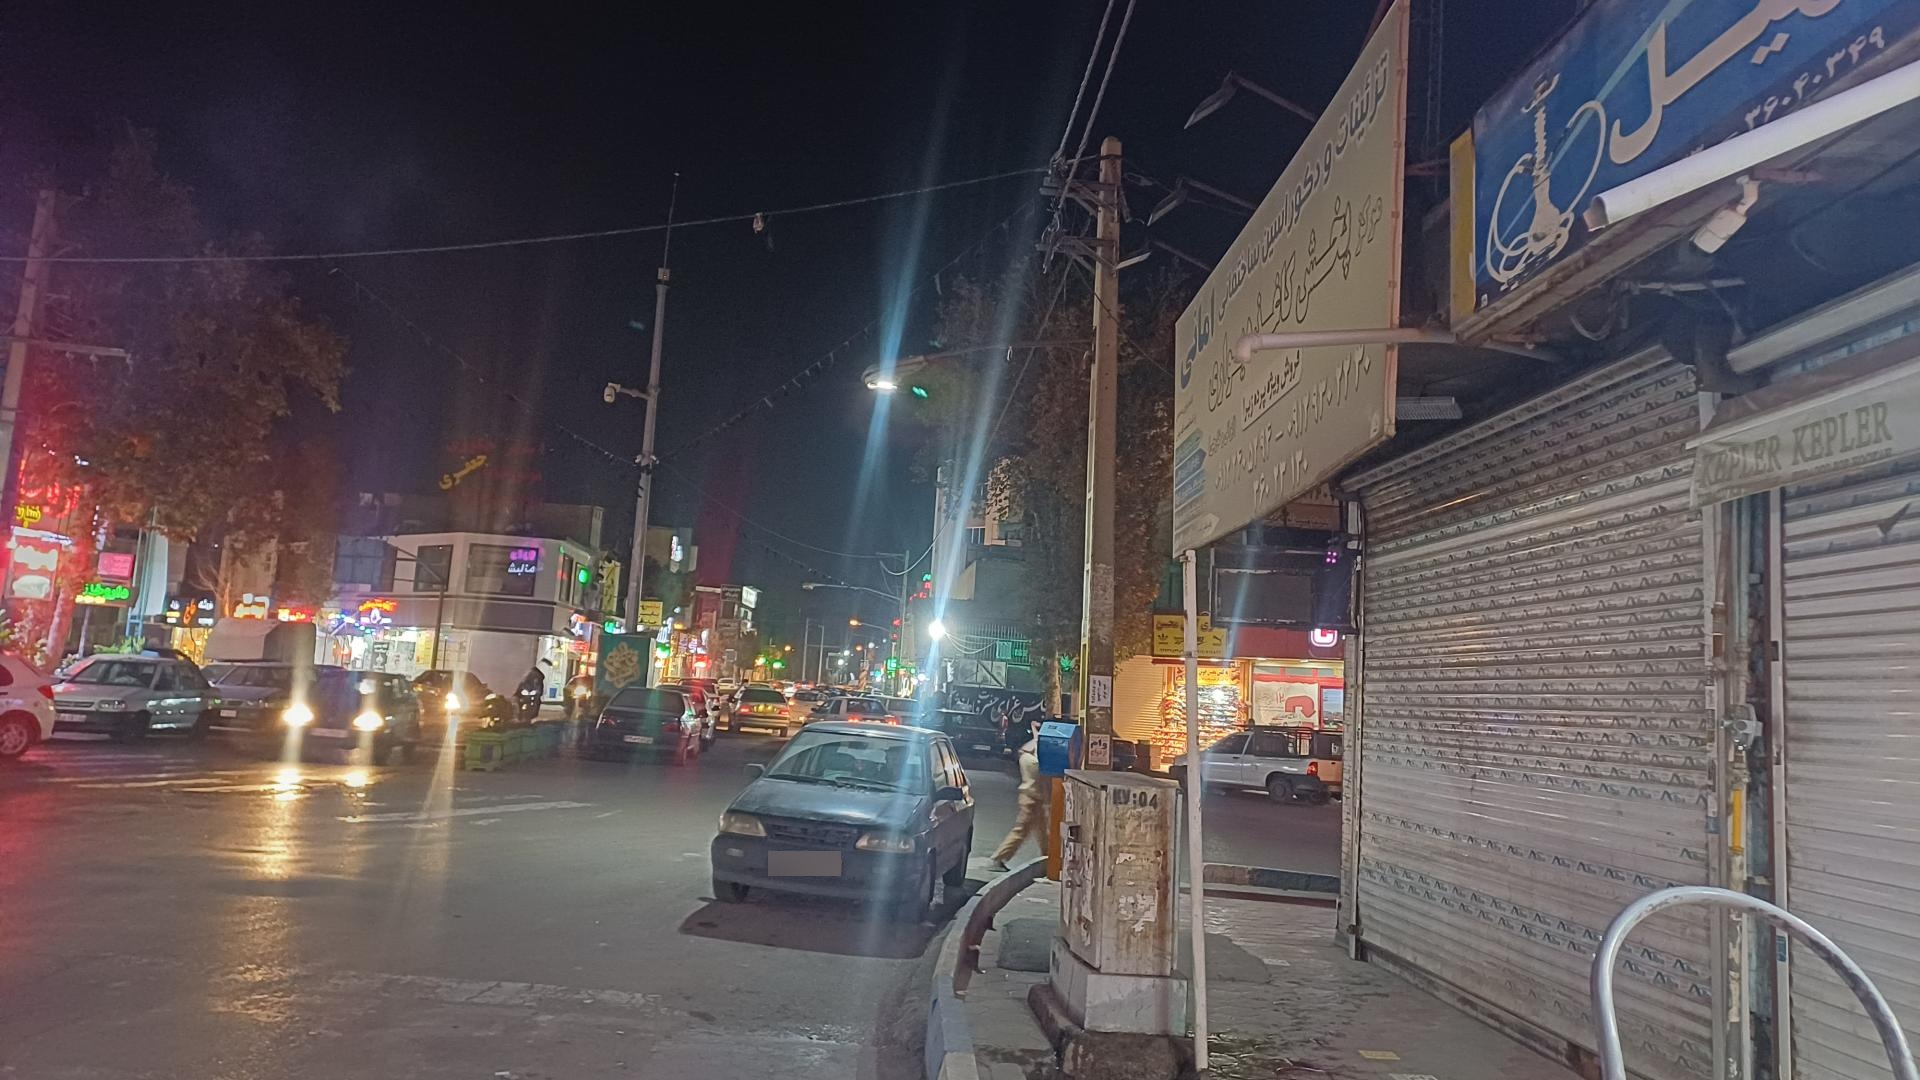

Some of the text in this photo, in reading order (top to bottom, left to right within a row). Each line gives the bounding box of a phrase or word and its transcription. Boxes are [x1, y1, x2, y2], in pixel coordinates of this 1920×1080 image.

[1335, 52, 1388, 156] تزئینات
[1323, 142, 1332, 186] و
[1355, 194, 1382, 257] مرکز
[1218, 243, 1260, 322] ساختمانی
[1296, 195, 1352, 325] پخش
[1180, 287, 1215, 390] امانی
[1281, 349, 1300, 390] فروش
[1791, 401, 1894, 466] KEPLER
[1091, 739, 1108, 750] وام
